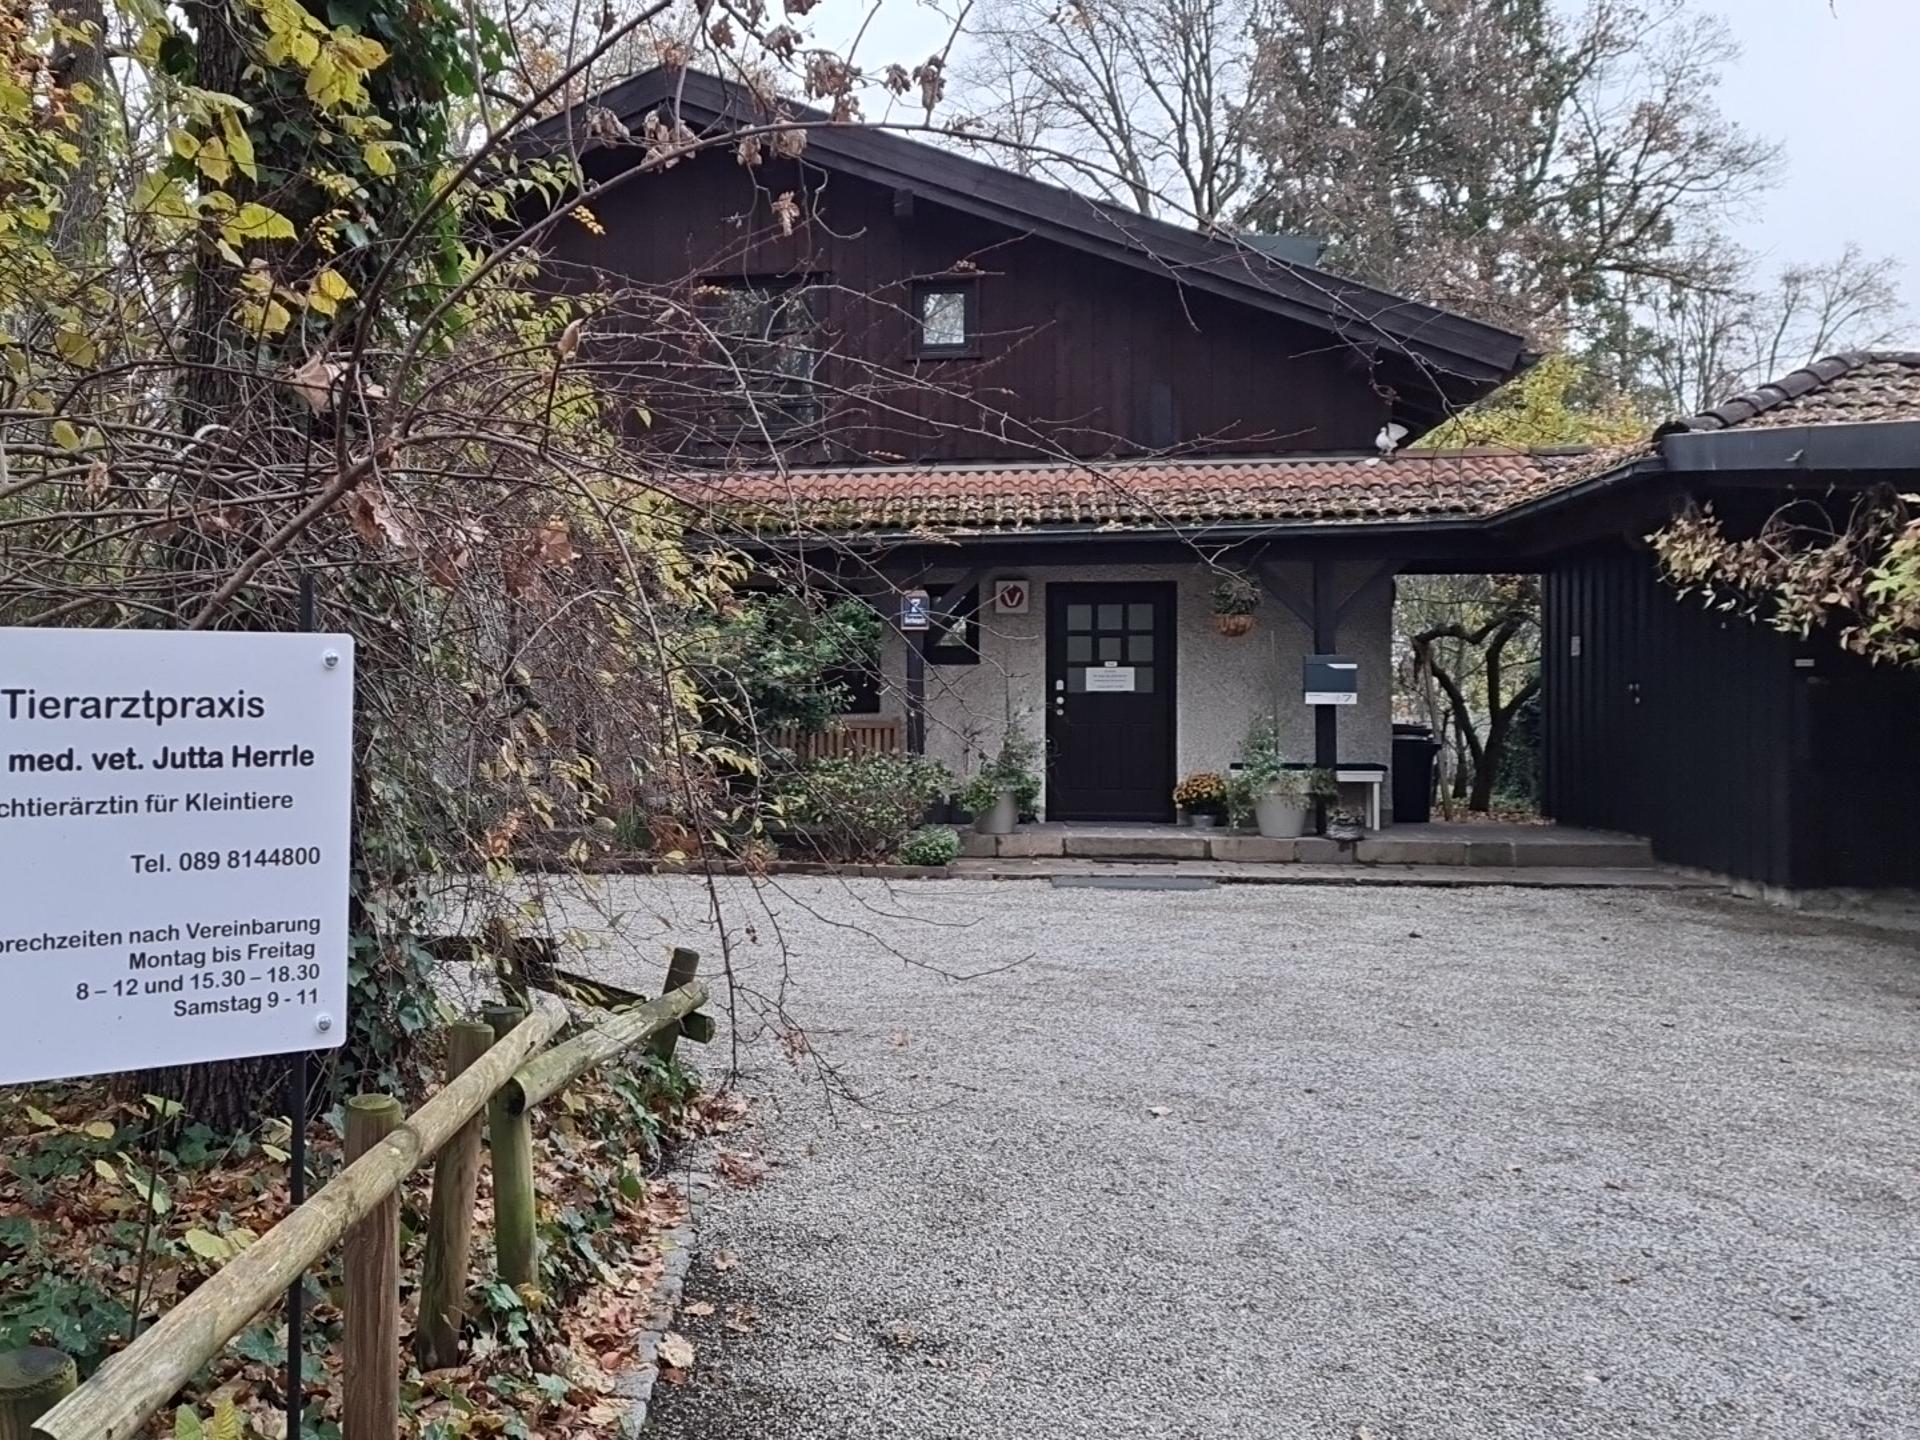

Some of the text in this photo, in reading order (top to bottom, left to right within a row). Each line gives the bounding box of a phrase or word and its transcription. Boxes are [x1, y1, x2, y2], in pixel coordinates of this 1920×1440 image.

[1, 689, 265, 726] Tierarztpraxis
[8, 743, 315, 772] med. vet. Jutta Herrle
[145, 794, 179, 813] für
[185, 792, 294, 812] Kleintiere
[130, 846, 321, 874] Tel. 089 8144800
[129, 924, 180, 945] nach
[185, 918, 321, 941] Vereinbarung
[129, 943, 316, 970] Montag bis Freitag
[76, 982, 89, 1001] 8
[113, 978, 139, 997] 12
[144, 974, 184, 995] und
[190, 968, 246, 991] 15.30
[267, 963, 321, 983] 18.30
[173, 995, 262, 1017] Samstag
[267, 991, 279, 1008] 9
[297, 988, 317, 1005] 11
